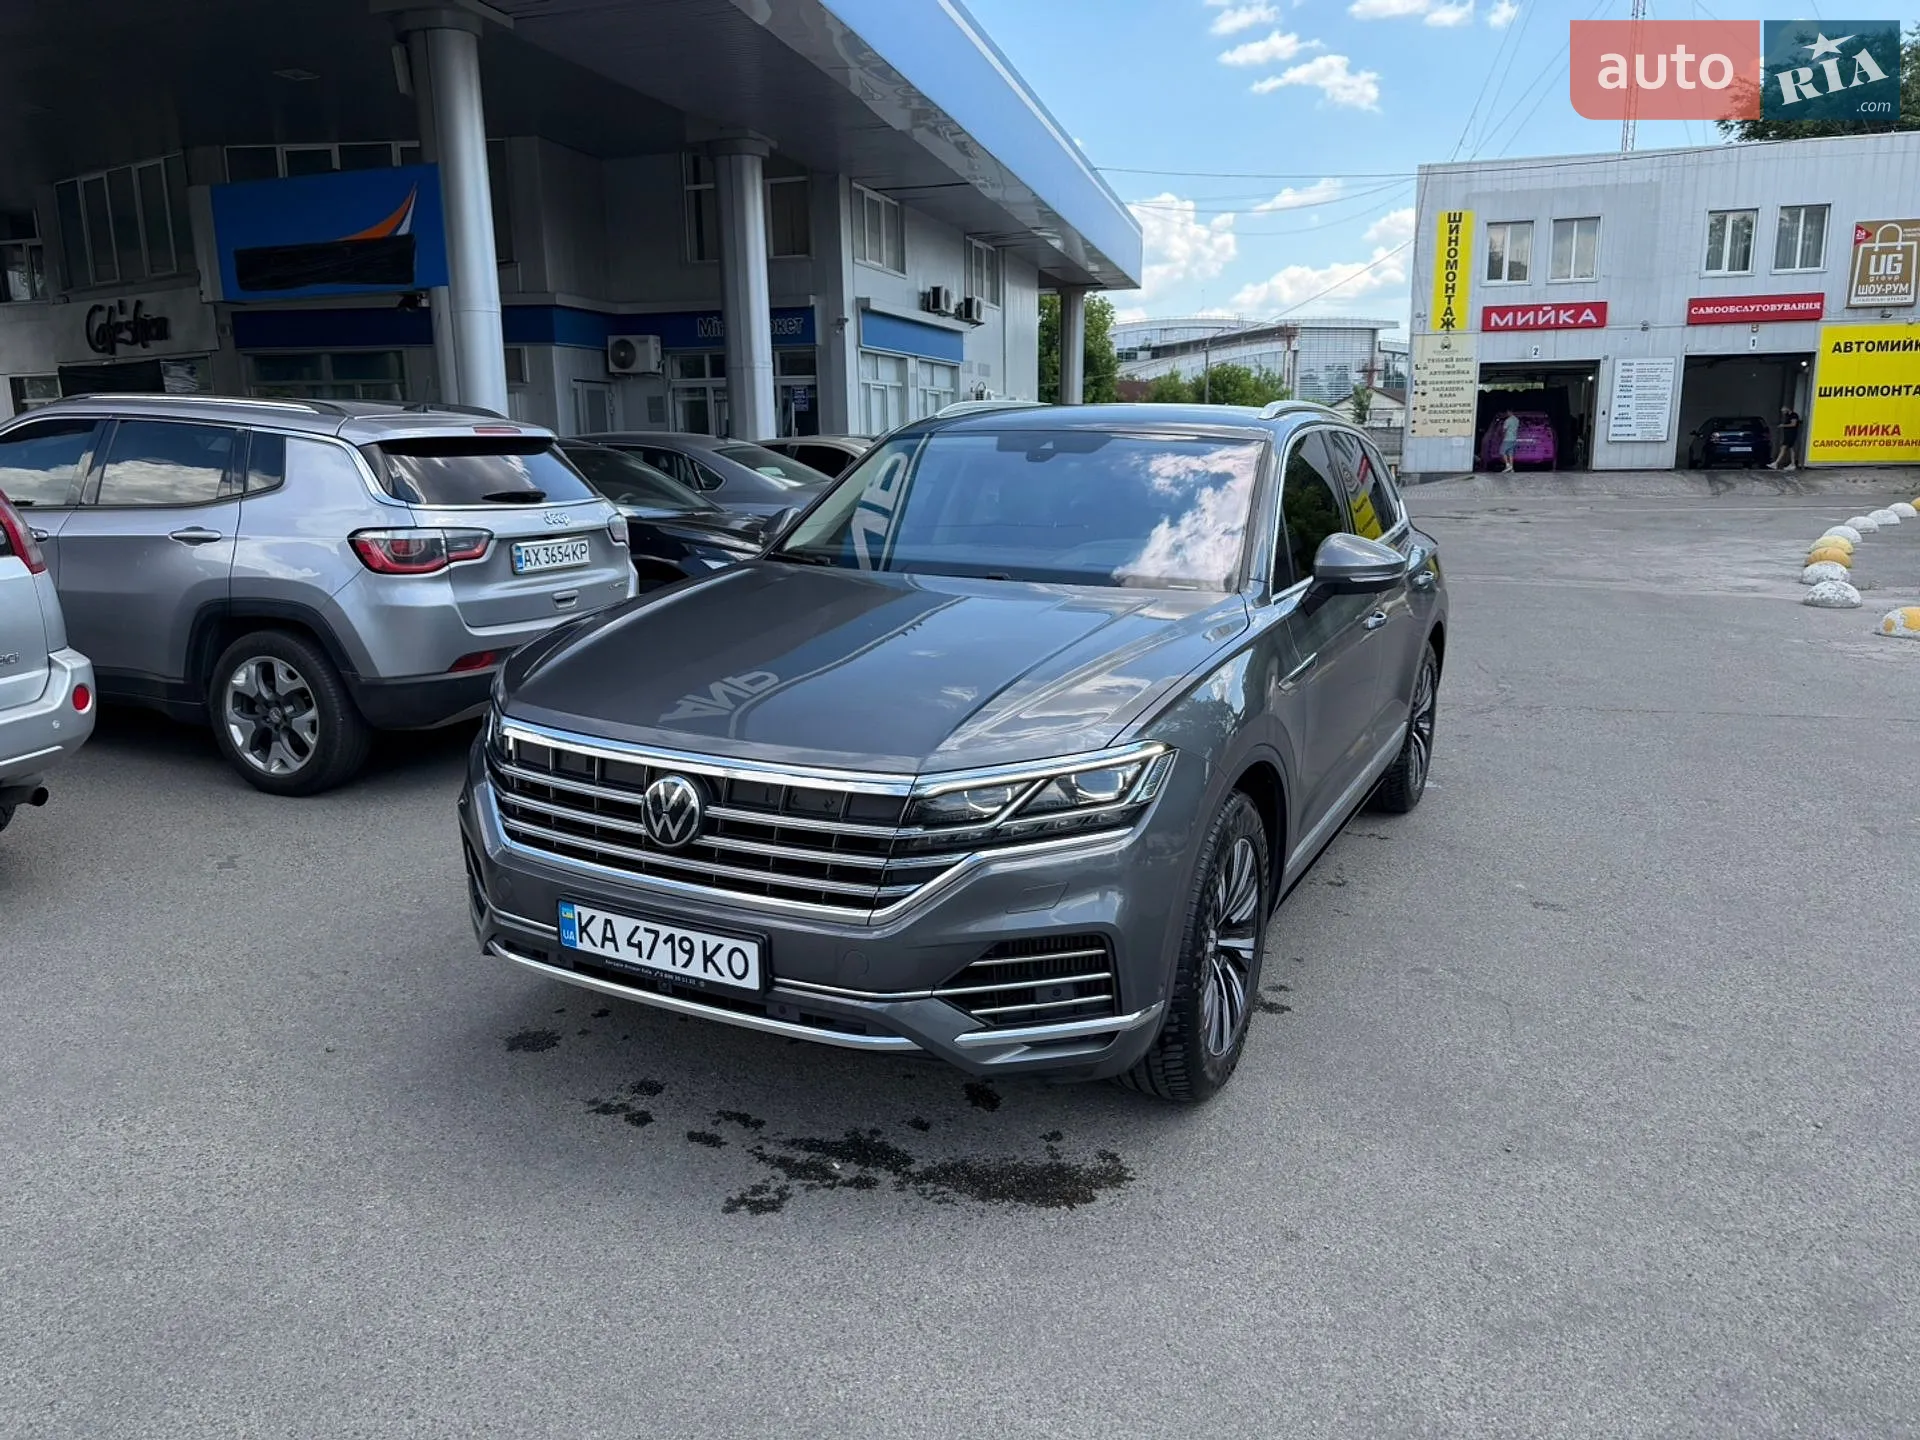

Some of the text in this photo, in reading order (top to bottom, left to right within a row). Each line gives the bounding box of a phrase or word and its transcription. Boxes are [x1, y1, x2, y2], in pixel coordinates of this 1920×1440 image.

[1441, 212, 1462, 332] ШИНОМОНТАЖ
[1858, 283, 1909, 295] ШОУ-РУМ
[1490, 306, 1597, 327] МИЙКА
[1844, 421, 1901, 436] МИЙКА
[544, 511, 570, 526] Jeep
[524, 542, 588, 567] AX 3654 KP
[563, 929, 575, 941] UA
[577, 911, 620, 953] KA
[626, 925, 696, 969] 4719
[702, 940, 750, 981] KO
